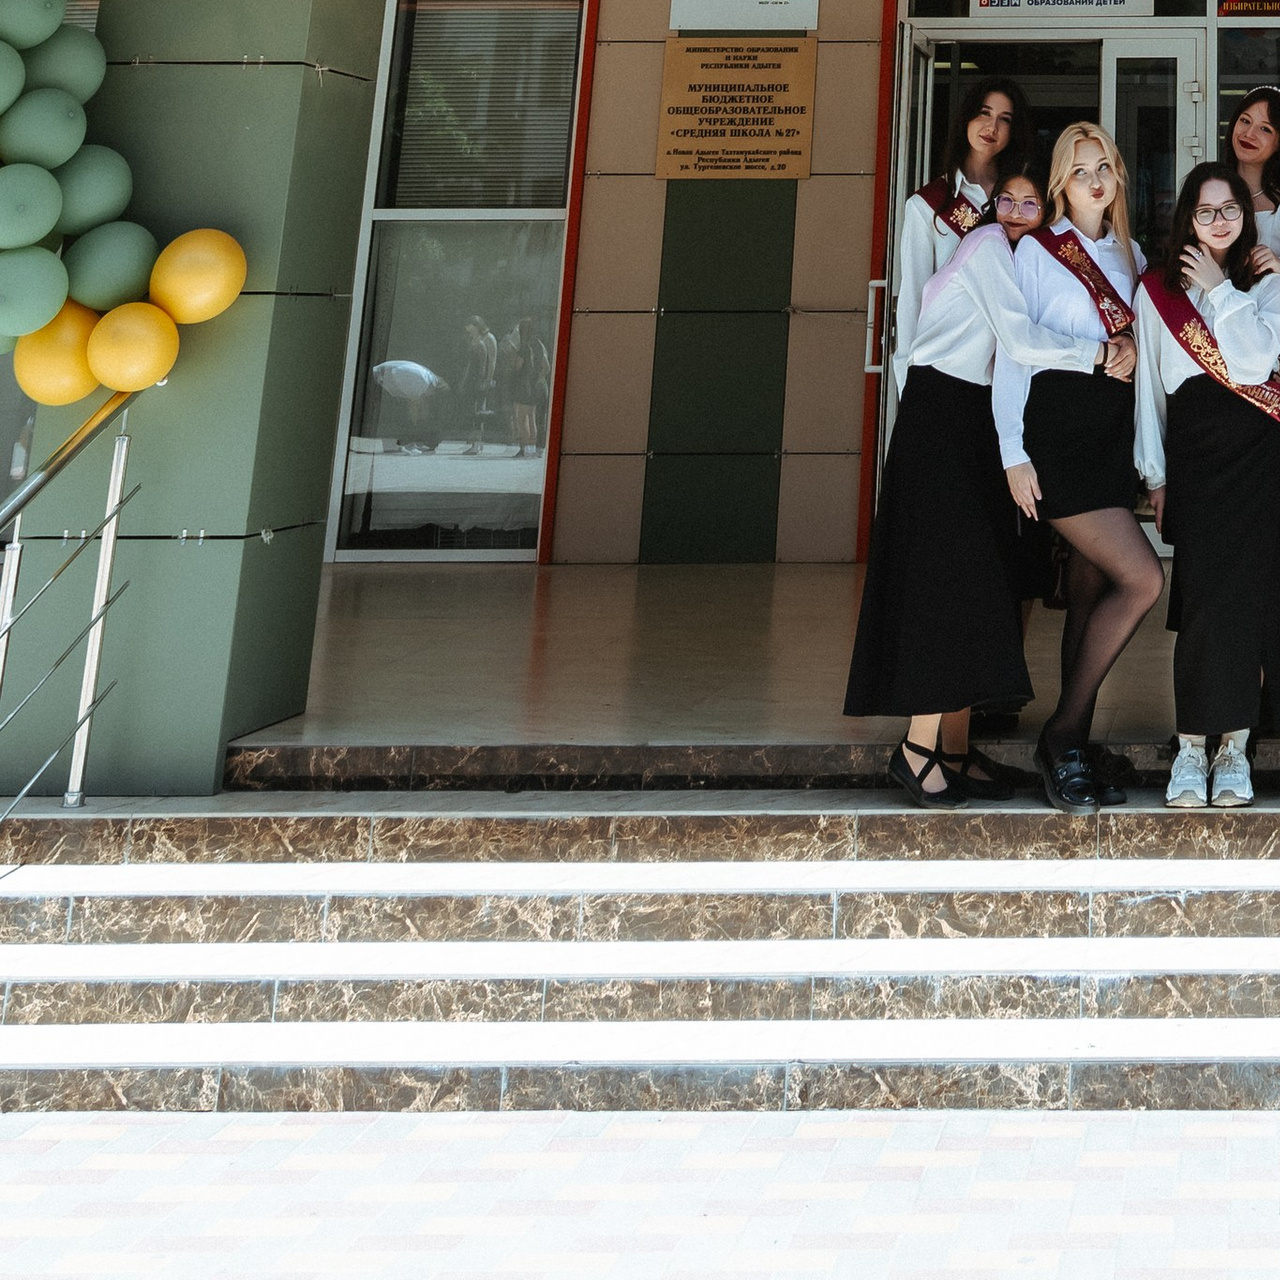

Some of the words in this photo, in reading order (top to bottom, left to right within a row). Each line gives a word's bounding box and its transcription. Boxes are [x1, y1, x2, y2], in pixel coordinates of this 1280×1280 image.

[688, 84, 790, 93] МУНИЦИПАЛЬНОЕ
[701, 95, 774, 104] БЮДЖЕТНОЕ
[667, 106, 807, 115] ОБЩЕОБРАЗОВАТЕЛЬНОЕ
[698, 117, 775, 126] УЧРЕЖДЕНИЕ
[670, 129, 726, 138] «СРЕДНЯЯ
[730, 129, 771, 137] ШКОЛА
